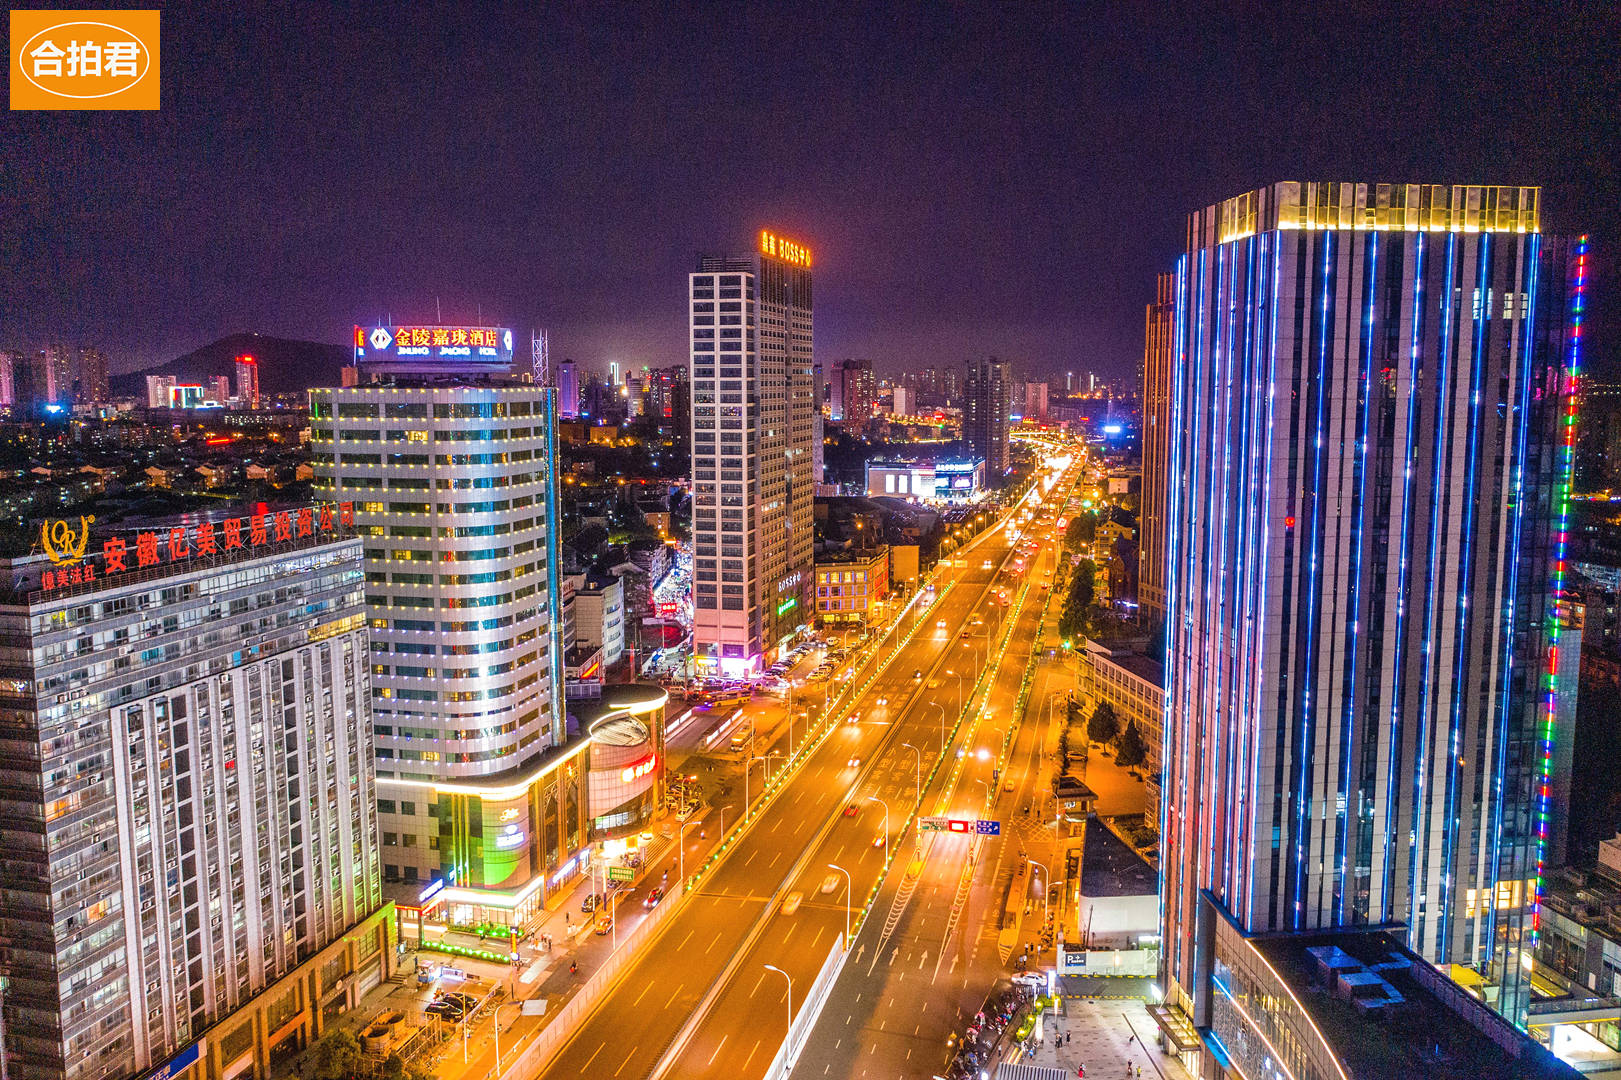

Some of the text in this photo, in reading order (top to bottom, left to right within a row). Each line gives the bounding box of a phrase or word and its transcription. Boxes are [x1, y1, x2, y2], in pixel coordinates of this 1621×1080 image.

[395, 327, 497, 347] 金陵嘉珑酒店
[103, 501, 354, 574] 安徽亿美贸易投资公司
